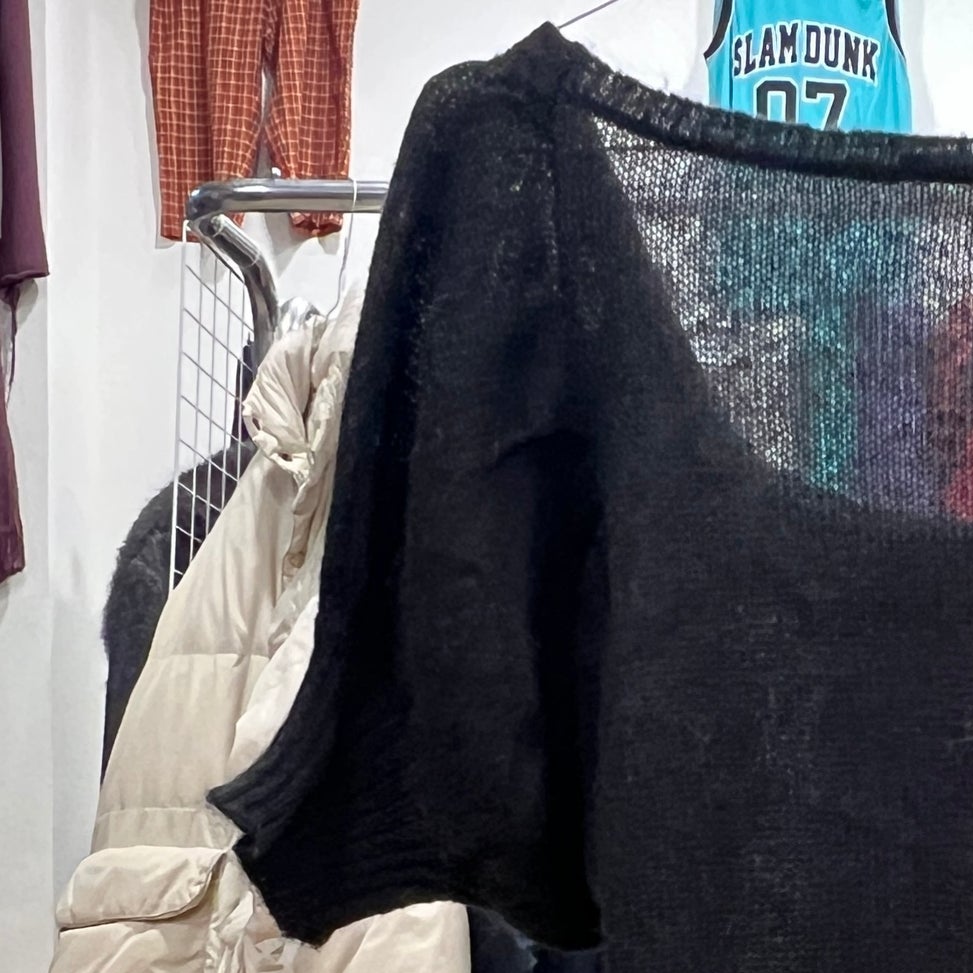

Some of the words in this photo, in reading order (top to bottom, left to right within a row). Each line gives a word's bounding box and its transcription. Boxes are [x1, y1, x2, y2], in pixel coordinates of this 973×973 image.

[733, 22, 799, 77] SLAM
[803, 23, 879, 83] DUNK
[756, 79, 848, 130] 07
